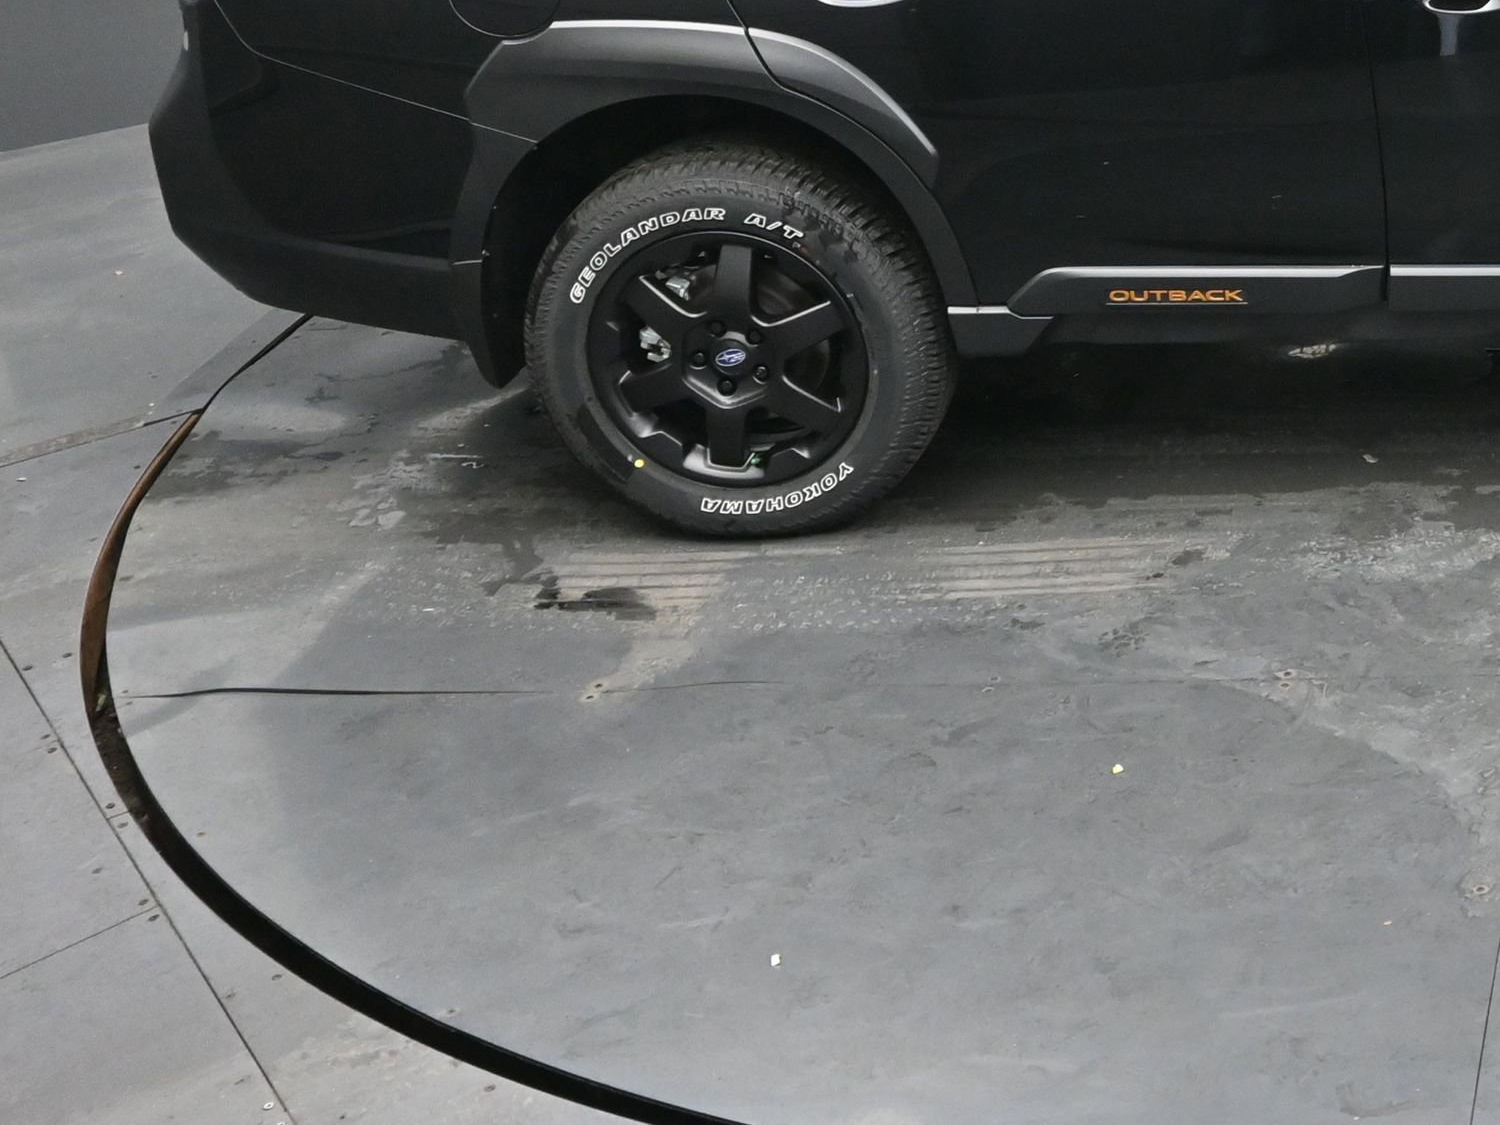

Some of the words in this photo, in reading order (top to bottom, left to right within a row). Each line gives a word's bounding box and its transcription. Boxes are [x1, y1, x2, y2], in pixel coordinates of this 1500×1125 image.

[569, 207, 727, 304] GEOLANDAR
[743, 213, 804, 241] A/T
[1108, 289, 1244, 302] OUTBACK
[700, 462, 854, 515] YOKOHAMA
